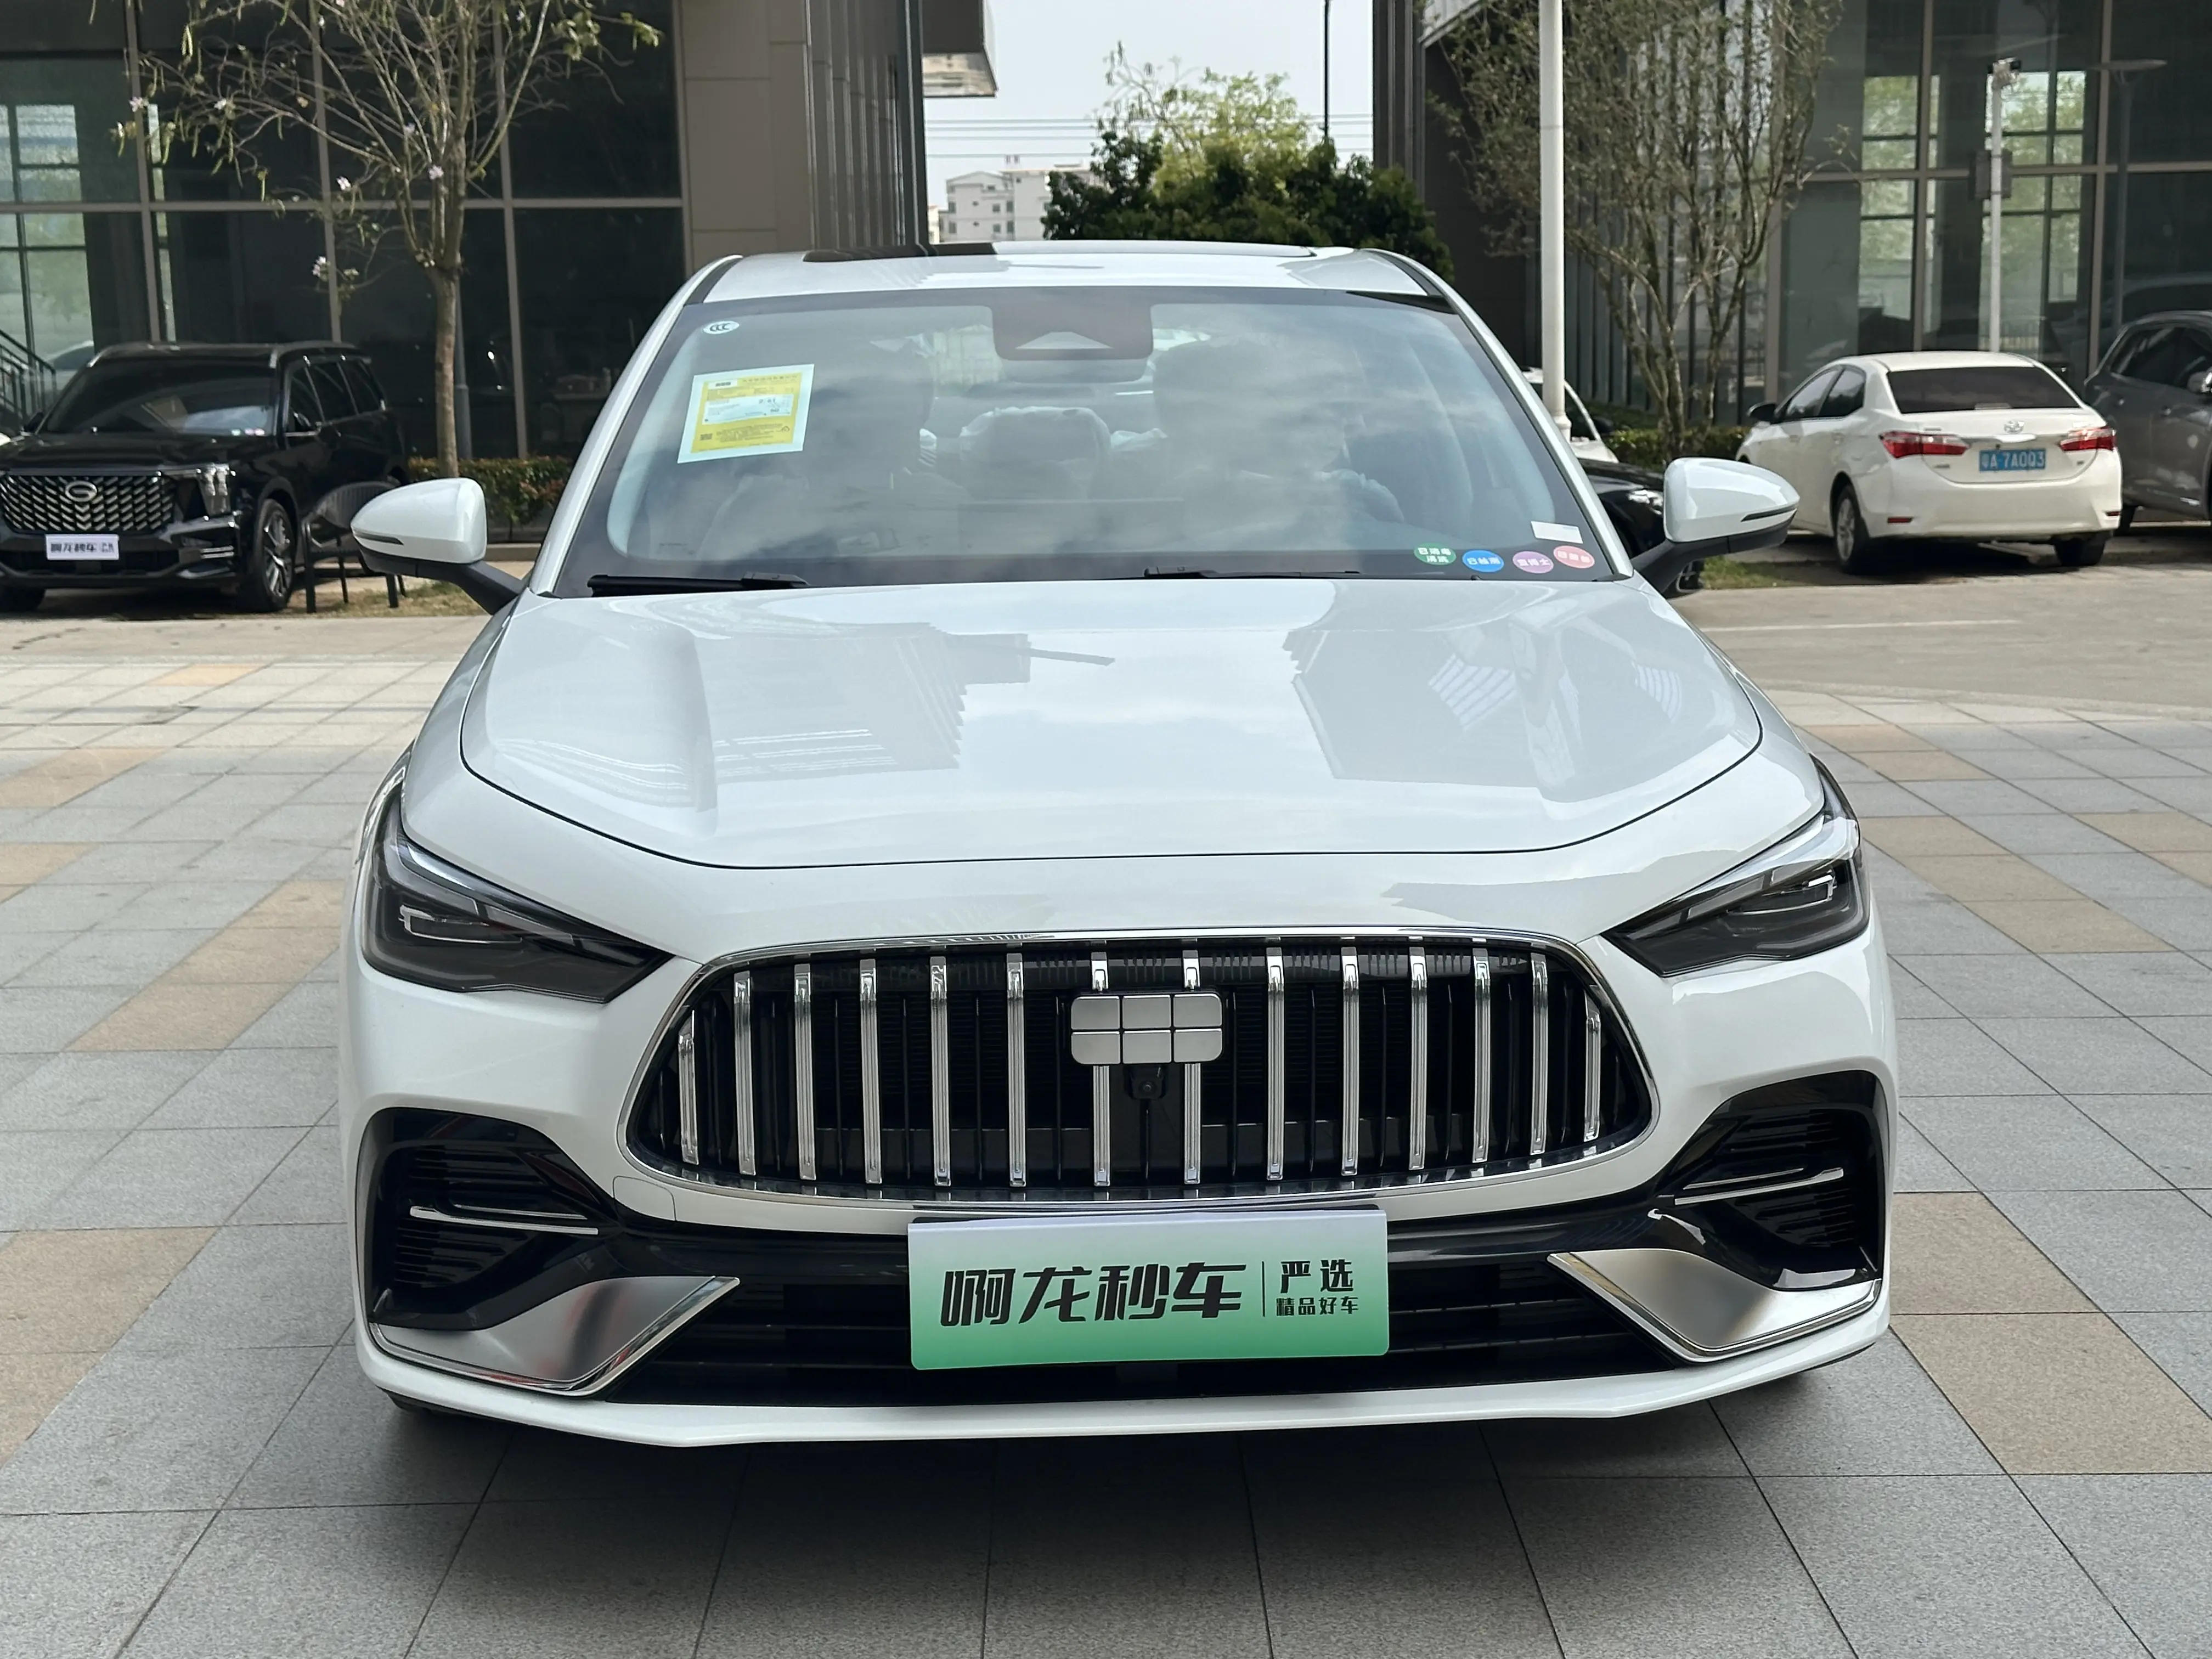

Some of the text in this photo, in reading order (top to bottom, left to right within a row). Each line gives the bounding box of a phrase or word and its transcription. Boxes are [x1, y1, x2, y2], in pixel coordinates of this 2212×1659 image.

[1280, 1258, 1353, 1294] 严选
[940, 1262, 1247, 1327] 啊龙秒车
[1276, 1296, 1359, 1316] 精品好车
